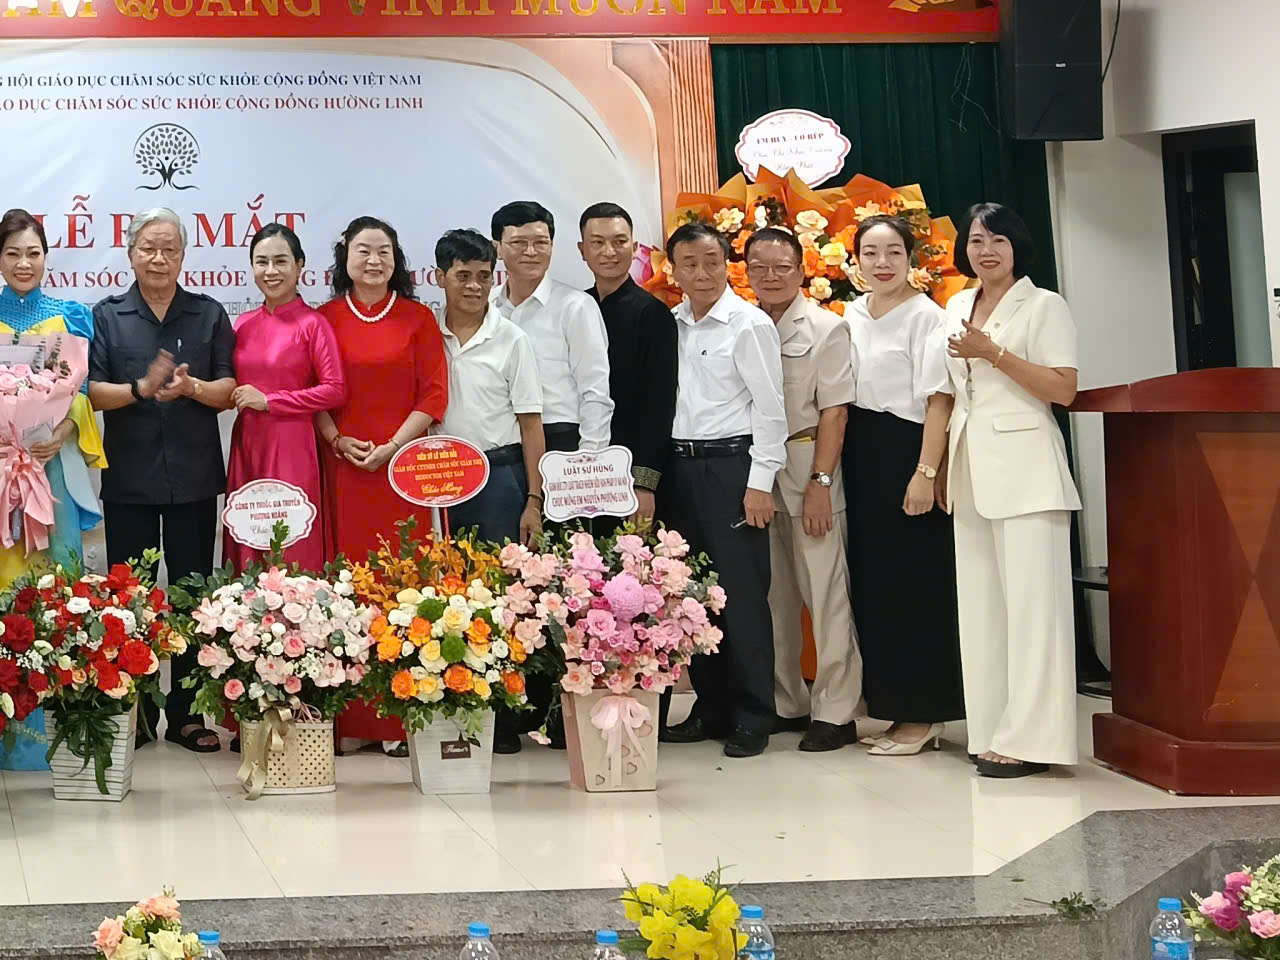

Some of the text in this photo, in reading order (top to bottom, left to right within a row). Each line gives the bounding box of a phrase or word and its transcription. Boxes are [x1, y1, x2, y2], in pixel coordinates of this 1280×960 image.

[8, 73, 33, 89] HỘI
[37, 72, 74, 87] GIÁO
[77, 75, 107, 90] DỤC
[110, 73, 153, 87] CHĂM
[157, 72, 185, 86] SÓC
[188, 72, 216, 86] SỨC
[220, 71, 261, 86] KHỎE
[264, 72, 304, 88] CỘNG
[308, 70, 348, 86] ĐỒNG
[353, 72, 385, 88] VIỆT
[389, 74, 421, 86] NAM
[19, 99, 51, 114] DỤC
[56, 96, 102, 111] CHĂM
[107, 95, 138, 110] SÓC
[142, 95, 172, 110] SỨC
[177, 94, 220, 110] KHỎE
[226, 95, 270, 112] CỘNG
[275, 93, 319, 109] ĐỒNG
[324, 95, 380, 109] HƯỜNG
[385, 97, 423, 109] LINH
[34, 194, 95, 249] LỄ
[192, 193, 306, 248] MẮT
[44, 267, 78, 288] ĂM
[84, 266, 128, 288] SÓC
[184, 265, 247, 287] KHỎE
[563, 466, 580, 476] LUẬT
[582, 465, 592, 474] SƯ
